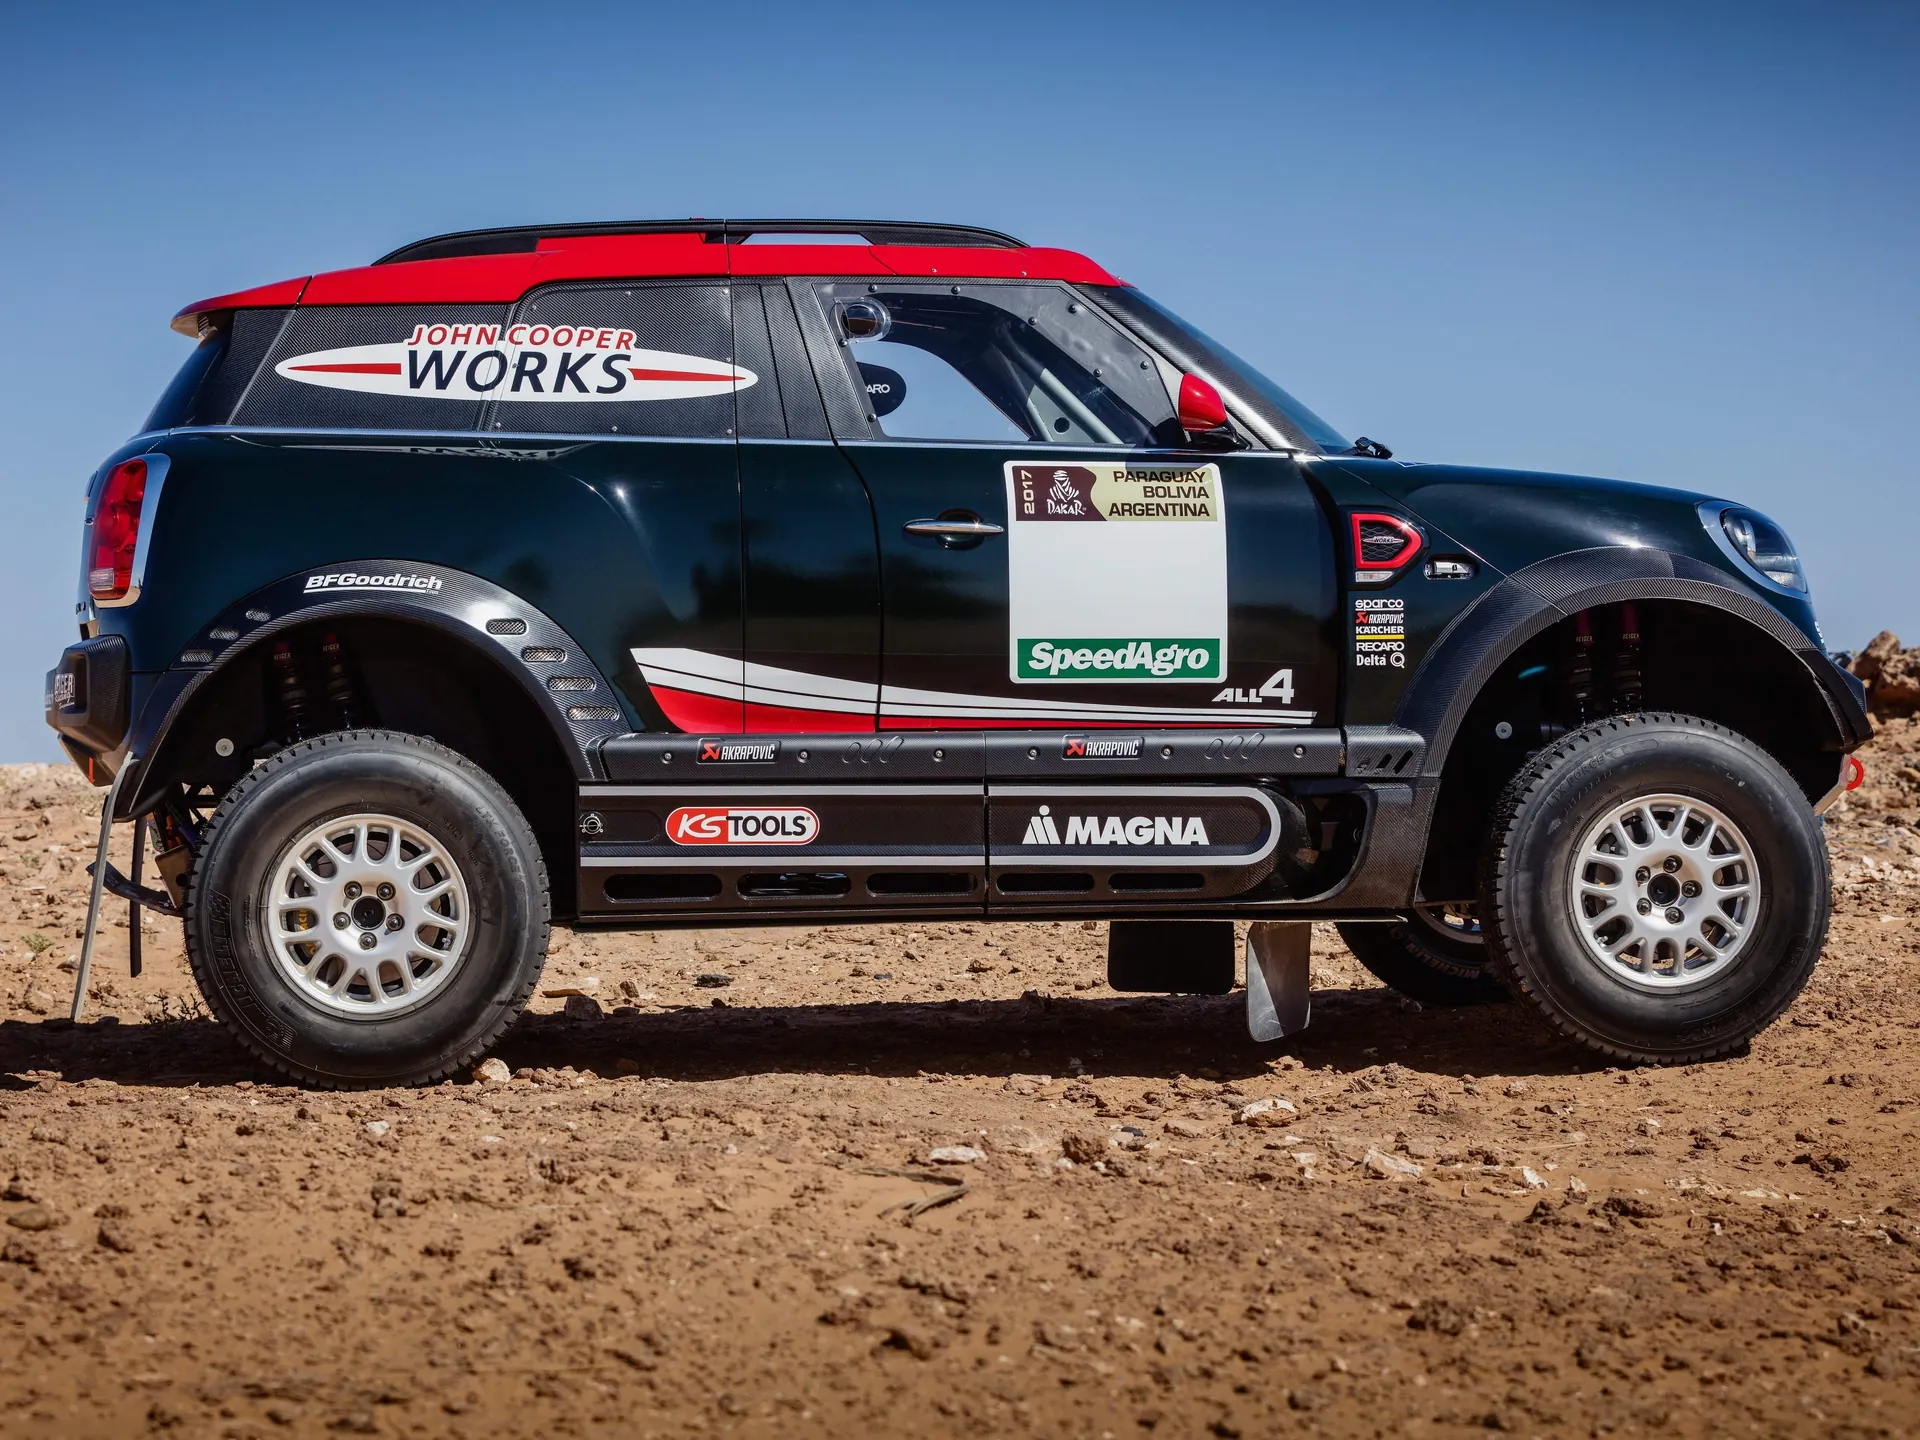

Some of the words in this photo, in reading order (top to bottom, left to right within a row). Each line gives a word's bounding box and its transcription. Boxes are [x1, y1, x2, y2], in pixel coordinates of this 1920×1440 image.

[407, 325, 498, 347] JOHN
[509, 326, 634, 351] COOPER
[408, 349, 632, 395] WORKS
[866, 383, 890, 394] ARO
[1113, 471, 1206, 483] PARAGUAY
[1020, 470, 1036, 515] 2017
[1143, 485, 1210, 499] BOLIVIA
[1046, 498, 1085, 516] DAKAR
[1108, 502, 1210, 518] ARGENTINA
[305, 573, 443, 590] BFGoodrich
[1355, 599, 1404, 611] sparco
[1356, 641, 1405, 652] RECARO
[1028, 641, 1210, 676] SpeedAgro
[1356, 654, 1387, 666] Delta
[721, 743, 776, 761] AKRAPOVIČ
[1566, 753, 1606, 786] FORCE
[677, 813, 727, 838] KS
[726, 815, 807, 836] TOOLS
[1064, 816, 1210, 845] MAGNA
